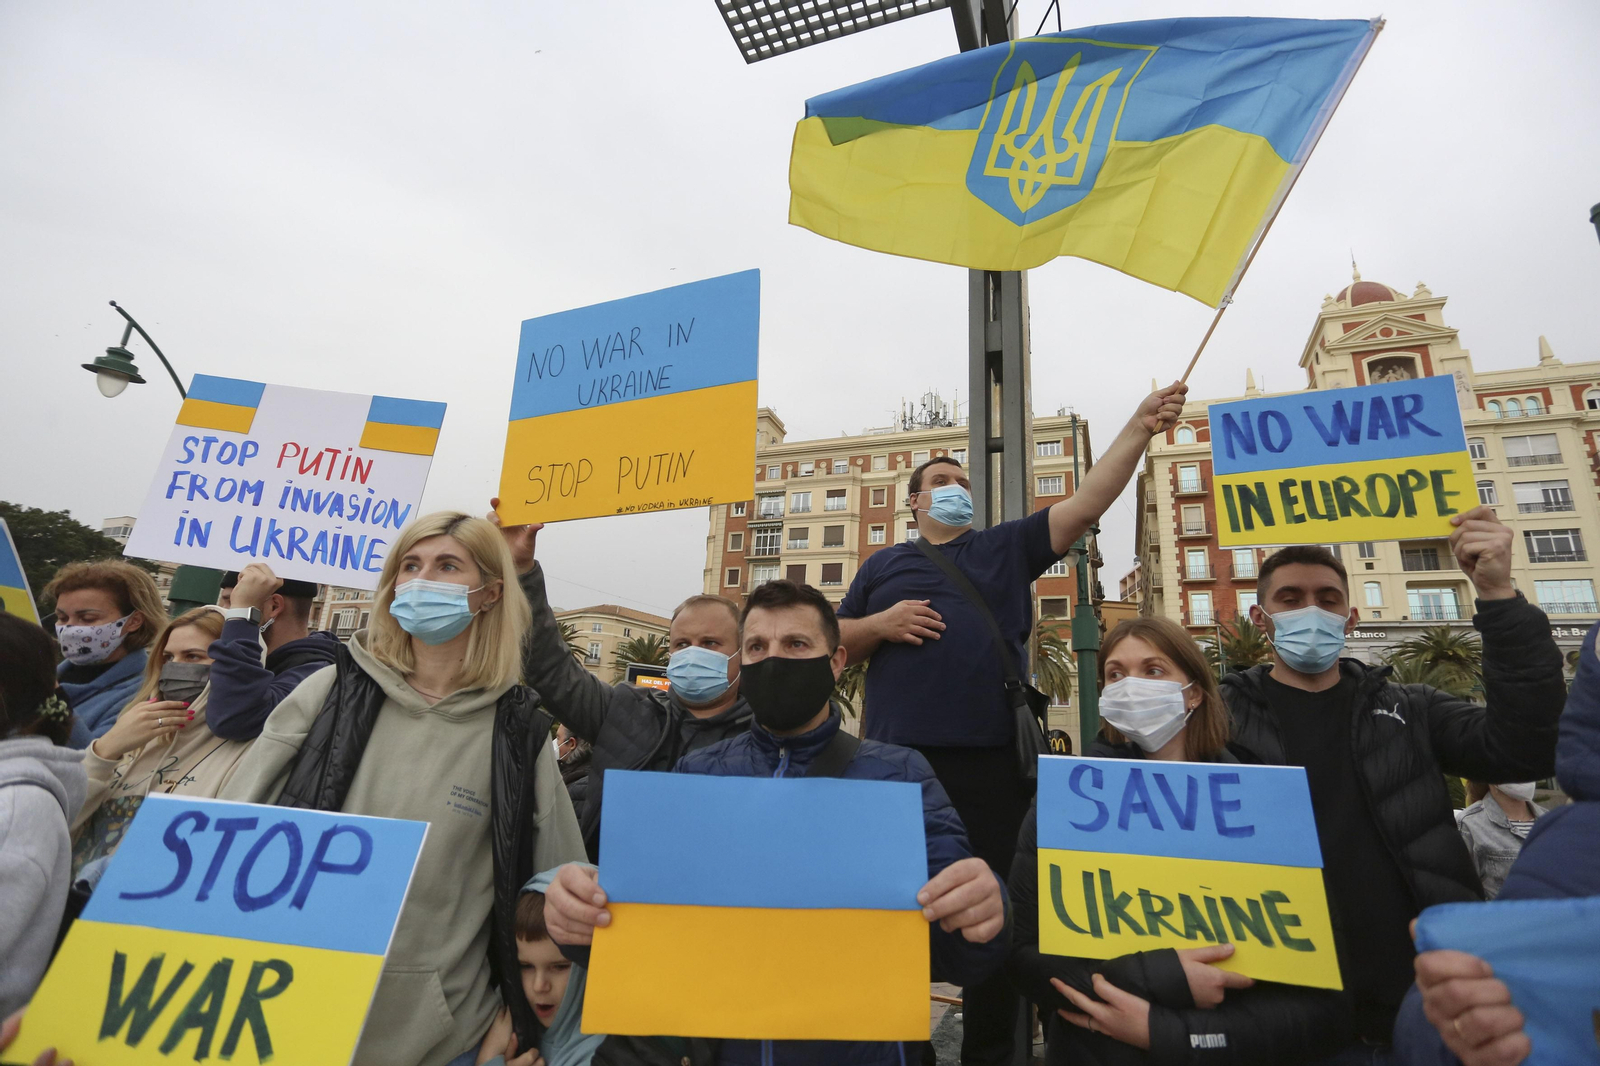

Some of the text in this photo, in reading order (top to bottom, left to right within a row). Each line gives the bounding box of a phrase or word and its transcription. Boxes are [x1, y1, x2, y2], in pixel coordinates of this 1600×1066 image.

[527, 317, 696, 383] NO WAR IN
[577, 364, 673, 407] UKRAINE
[1221, 393, 1443, 460] NO WAR
[175, 435, 260, 467] STOP
[165, 470, 265, 507] FROM
[524, 449, 695, 506] STOP PUTIN
[637, 501, 665, 512] VODKA
[679, 497, 714, 506] UKRAINE
[1221, 468, 1461, 533] IN EUROPE
[1353, 630, 1386, 639] Banco
[1551, 626, 1589, 638] aja Ba
[463, 788, 475, 796] VOICE
[1068, 763, 1256, 839] SAVE
[118, 810, 374, 913] STOP
[97, 949, 295, 1066] WAR
[1189, 1033, 1228, 1049] PUMA
